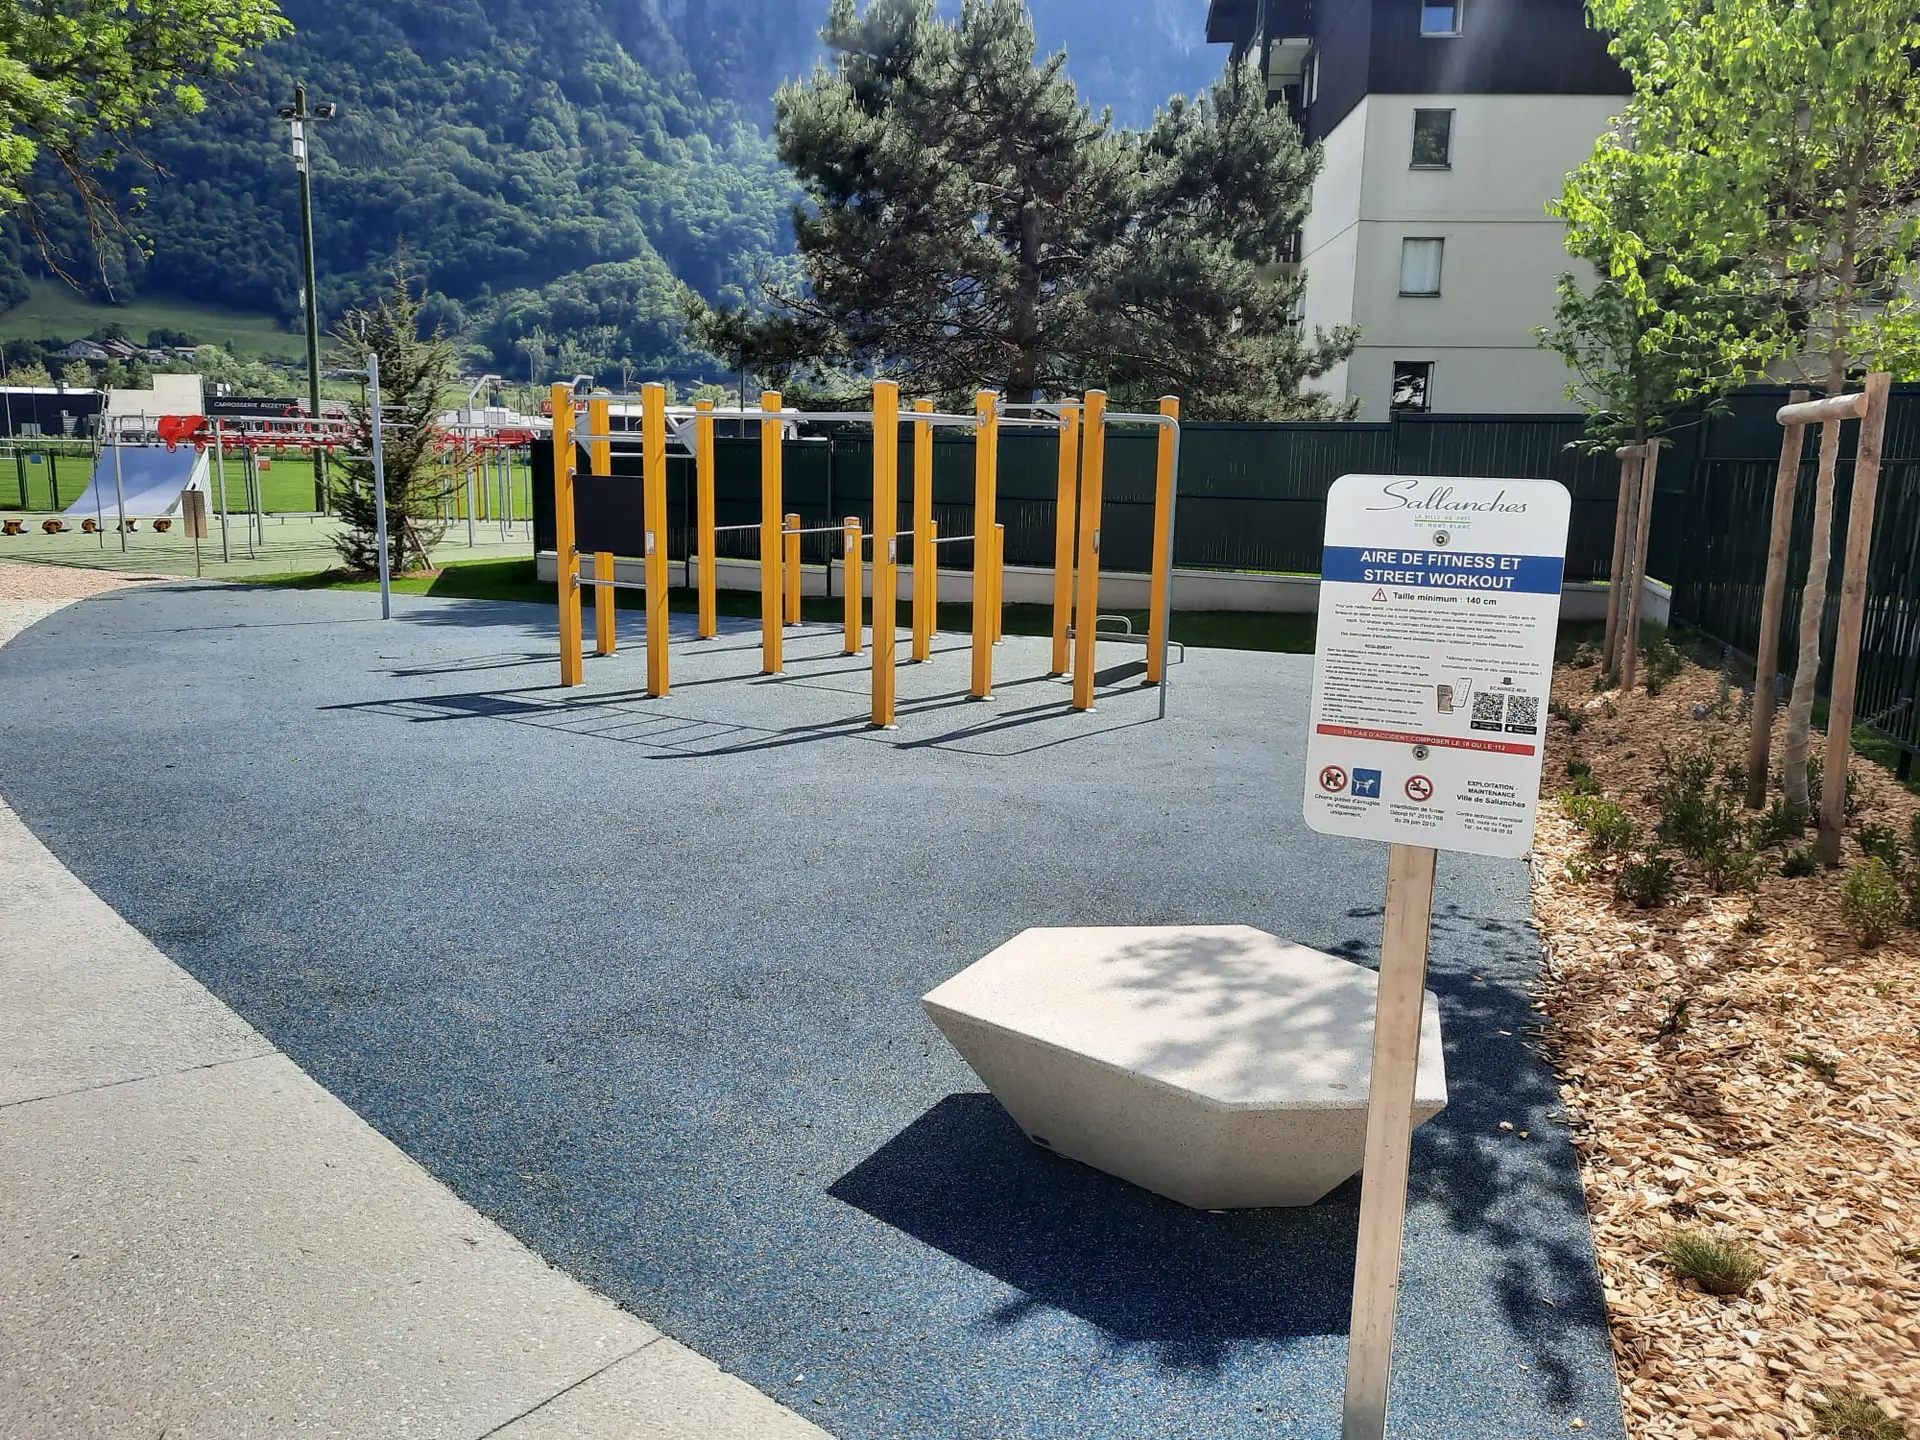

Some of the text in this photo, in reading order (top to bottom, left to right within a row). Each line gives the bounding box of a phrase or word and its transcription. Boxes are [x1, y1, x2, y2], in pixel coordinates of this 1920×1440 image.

[1365, 479, 1528, 513] Sallanches
[1360, 551, 1521, 570] AIRE DE FITNESS ET
[1364, 569, 1514, 589] STREET WORKOUT
[1393, 592, 1415, 601] Taille
[1417, 594, 1457, 604] minimum
[1466, 597, 1481, 605] 140
[1368, 731, 1408, 741] D'ACCIDENT
[1410, 735, 1449, 745] COMPOSER
[1467, 780, 1514, 790] EXPLOITATION
[1468, 788, 1515, 798] MAINTENANCE
[1456, 794, 1472, 802] Ville
[1485, 797, 1526, 808] Sallanches
